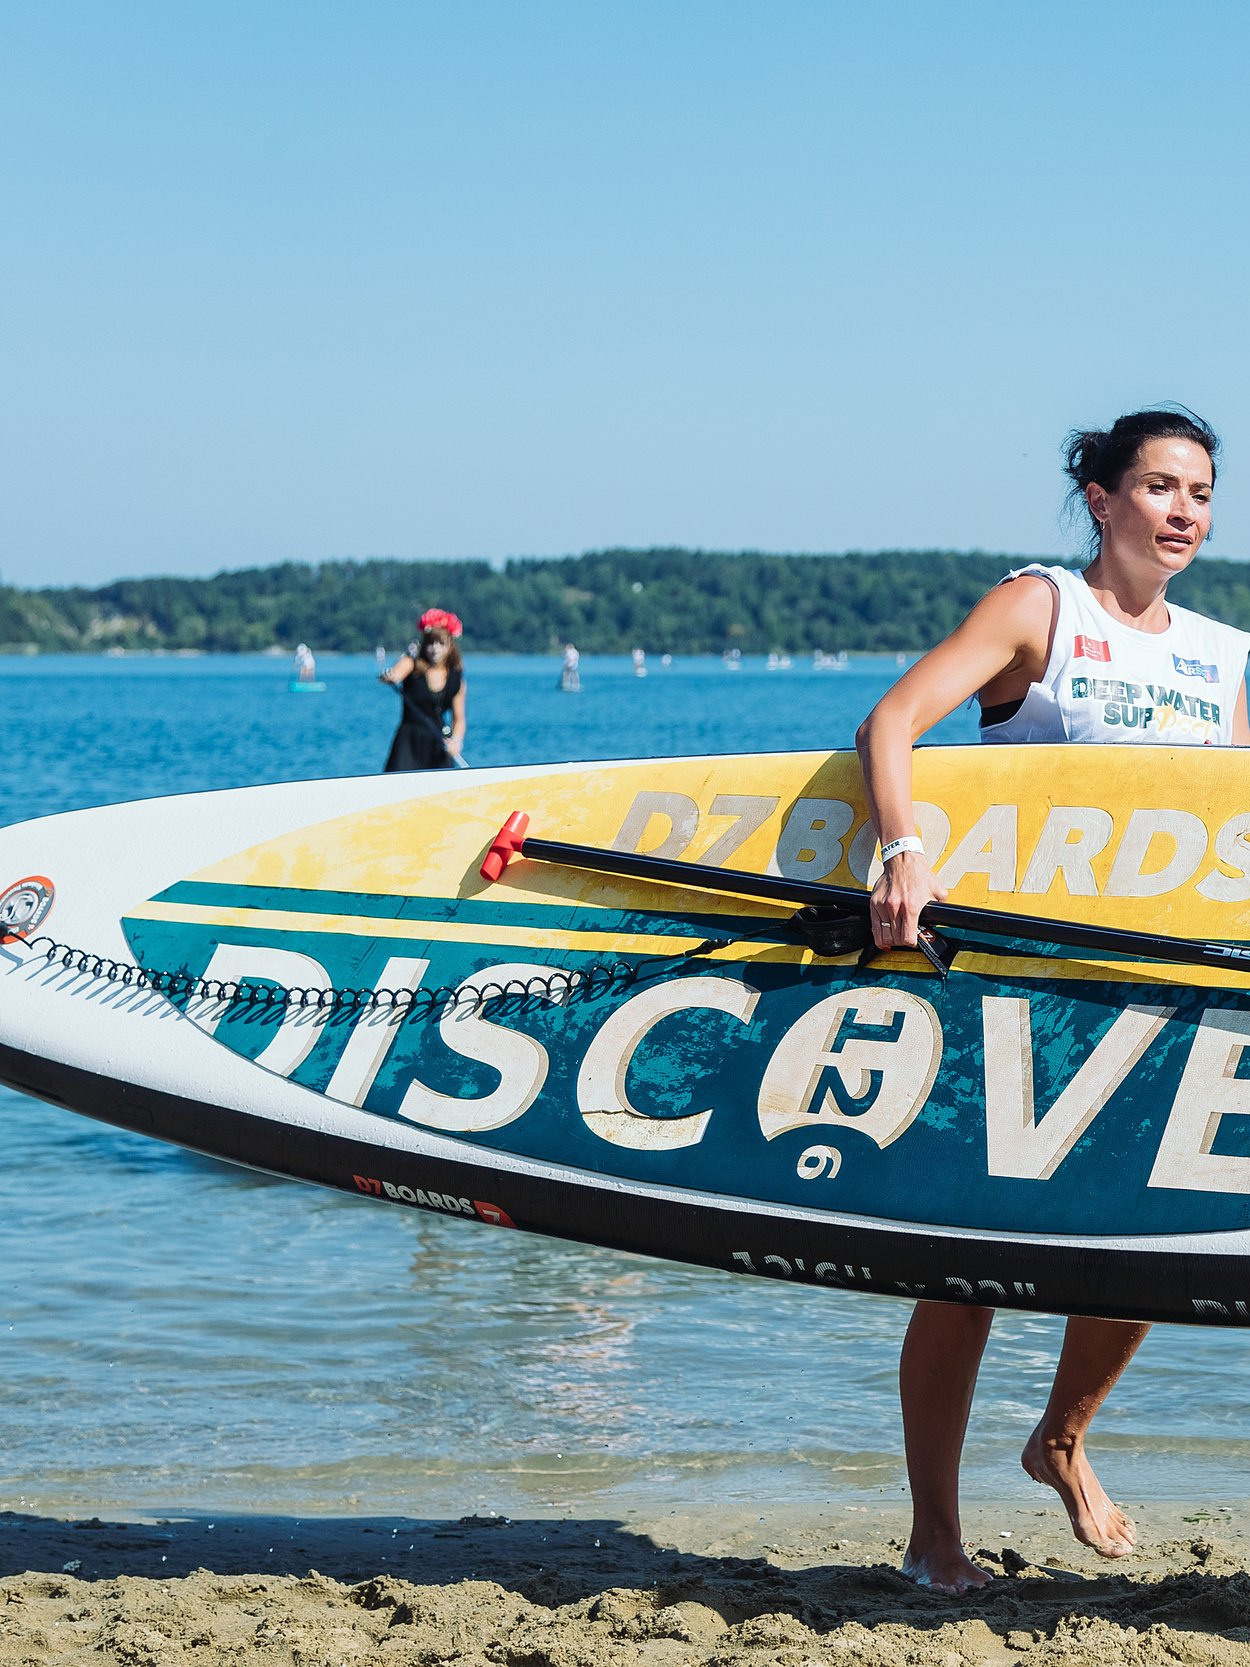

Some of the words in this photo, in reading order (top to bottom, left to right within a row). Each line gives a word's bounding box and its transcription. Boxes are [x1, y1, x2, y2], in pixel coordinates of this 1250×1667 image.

[1071, 677, 1142, 705] DEEP
[1146, 685, 1221, 728] WATER
[1104, 702, 1155, 729] SUP
[882, 841, 900, 855] ATER
[353, 1174, 476, 1216] D7BOARDS
